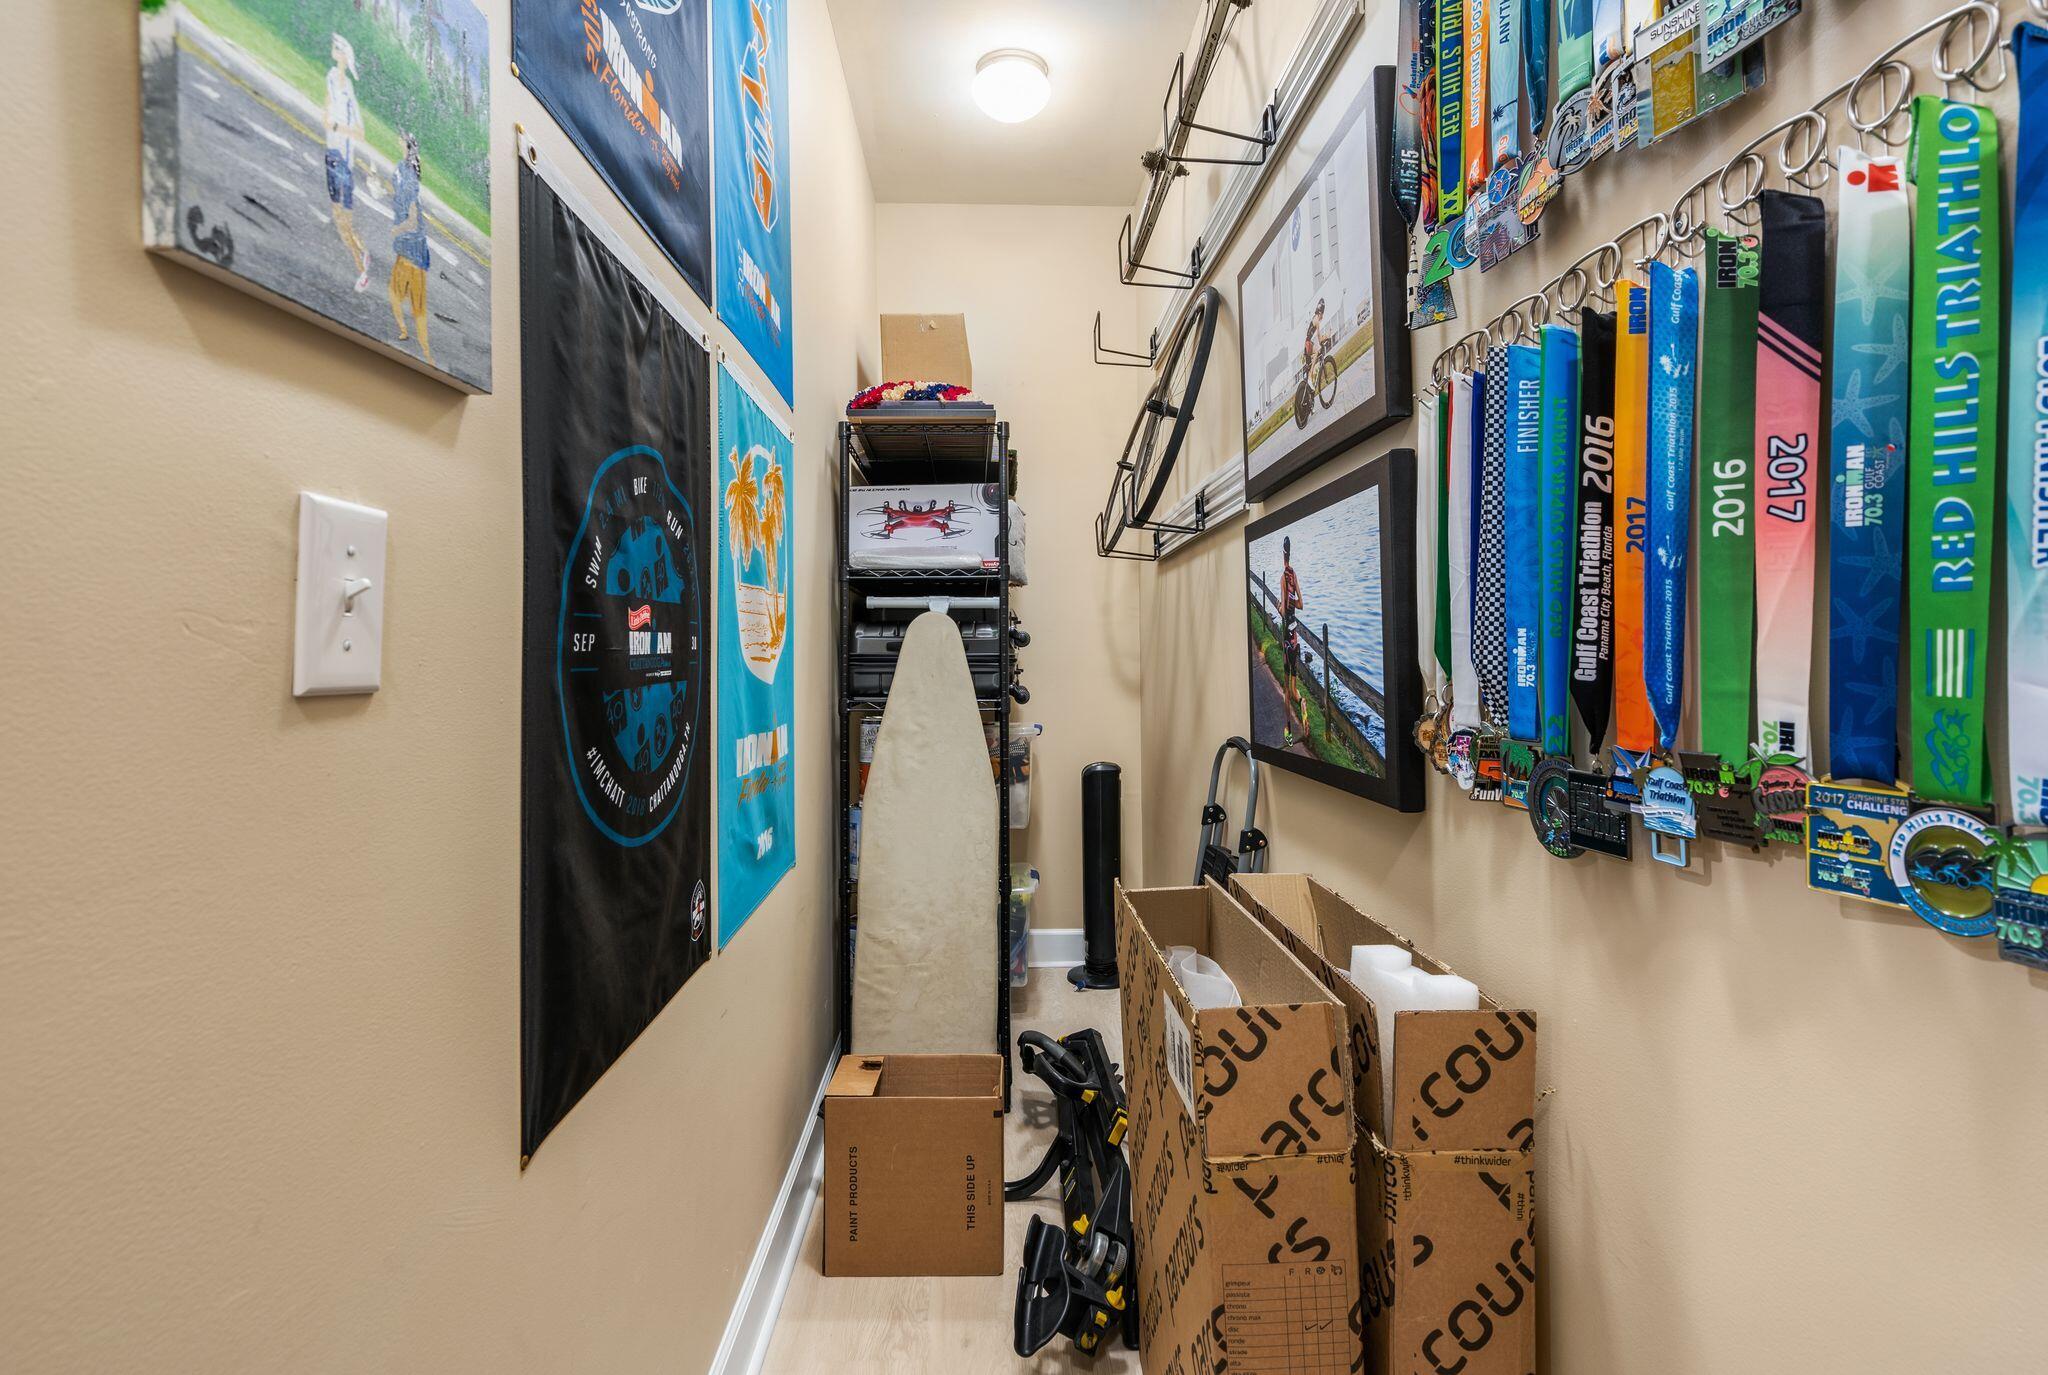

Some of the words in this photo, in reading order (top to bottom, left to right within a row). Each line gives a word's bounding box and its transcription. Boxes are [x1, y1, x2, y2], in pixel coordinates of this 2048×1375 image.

[1472, 0, 1483, 33] POS
[1500, 0, 1511, 45] ANYT
[1650, 2, 1700, 40] SUNSHINE
[1471, 33, 1481, 51] IS
[600, 8, 683, 171] IRONMAN
[1442, 45, 1462, 98] HILLS
[1471, 50, 1481, 128] ANYTHING
[1442, 101, 1460, 139] RED
[1936, 104, 1982, 348] TRIATHLO
[1737, 250, 1759, 288] 70.3
[1629, 288, 1647, 334] IRON
[1671, 305, 1682, 324] Gulf
[1517, 379, 1540, 453] FINISHER
[1668, 386, 1677, 409] 2015
[1551, 397, 1568, 468] SPRINT
[1666, 412, 1677, 458] Triathlon
[1933, 351, 1980, 487] HILLS
[1583, 415, 1614, 494] 2016
[633, 477, 647, 496] BIKE
[1666, 460, 1676, 489] Coast
[1768, 433, 1808, 523] 2017
[1844, 444, 1865, 527] IRONMAN
[1865, 467, 1875, 489] GULF
[1874, 459, 1885, 489] COAST
[1550, 471, 1567, 533] SUPER
[1666, 492, 1677, 511] Gulf
[1713, 459, 1747, 538] 2016
[1865, 494, 1883, 526] 70.3
[666, 510, 684, 540] RUN
[1603, 526, 1613, 560] Florida
[1626, 497, 1647, 553] 2017
[585, 535, 602, 589] SWIM
[1579, 502, 1602, 587] Triathlon
[1931, 496, 1976, 593] RED
[1549, 539, 1565, 593] HILLS
[1601, 561, 1612, 596] Beach,
[1600, 597, 1611, 618] City
[1664, 579, 1673, 602] 2015
[1549, 602, 1563, 638] RED
[1577, 588, 1599, 640] Coast
[1664, 605, 1673, 650] Triathlon
[573, 633, 595, 652] SEP
[1512, 628, 1527, 687] IRONMAN
[1599, 619, 1610, 661] Panama
[1526, 665, 1536, 687] 70.3
[1574, 640, 1597, 682] Gulf
[1664, 653, 1673, 682] Coast
[1664, 685, 1675, 705] Gulf
[586, 746, 625, 808] #IMCHATT
[1649, 777, 1663, 789] Gulf
[1688, 780, 1715, 795] 70.3
[1649, 789, 1686, 805] Triathlon
[1815, 790, 1844, 804] 2017
[1848, 793, 1889, 803] SUNSHINE
[1847, 800, 1908, 816] CHALLENG
[2017, 776, 2040, 825] 70.3
[1893, 833, 1907, 858] RED
[1907, 813, 1943, 833] HILLS
[1997, 920, 2043, 949] 70.3
[849, 1146, 858, 1207] PRODUCTS
[966, 1155, 976, 1171] UP
[1454, 1155, 1511, 1167] #thinkwider
[966, 1174, 976, 1201] SIDE
[1145, 1129, 1175, 1256] parcours
[849, 1211, 858, 1242] PAINT
[966, 1205, 976, 1231] THIS
[1164, 1194, 1205, 1328] parcours
[1289, 1268, 1294, 1276] F
